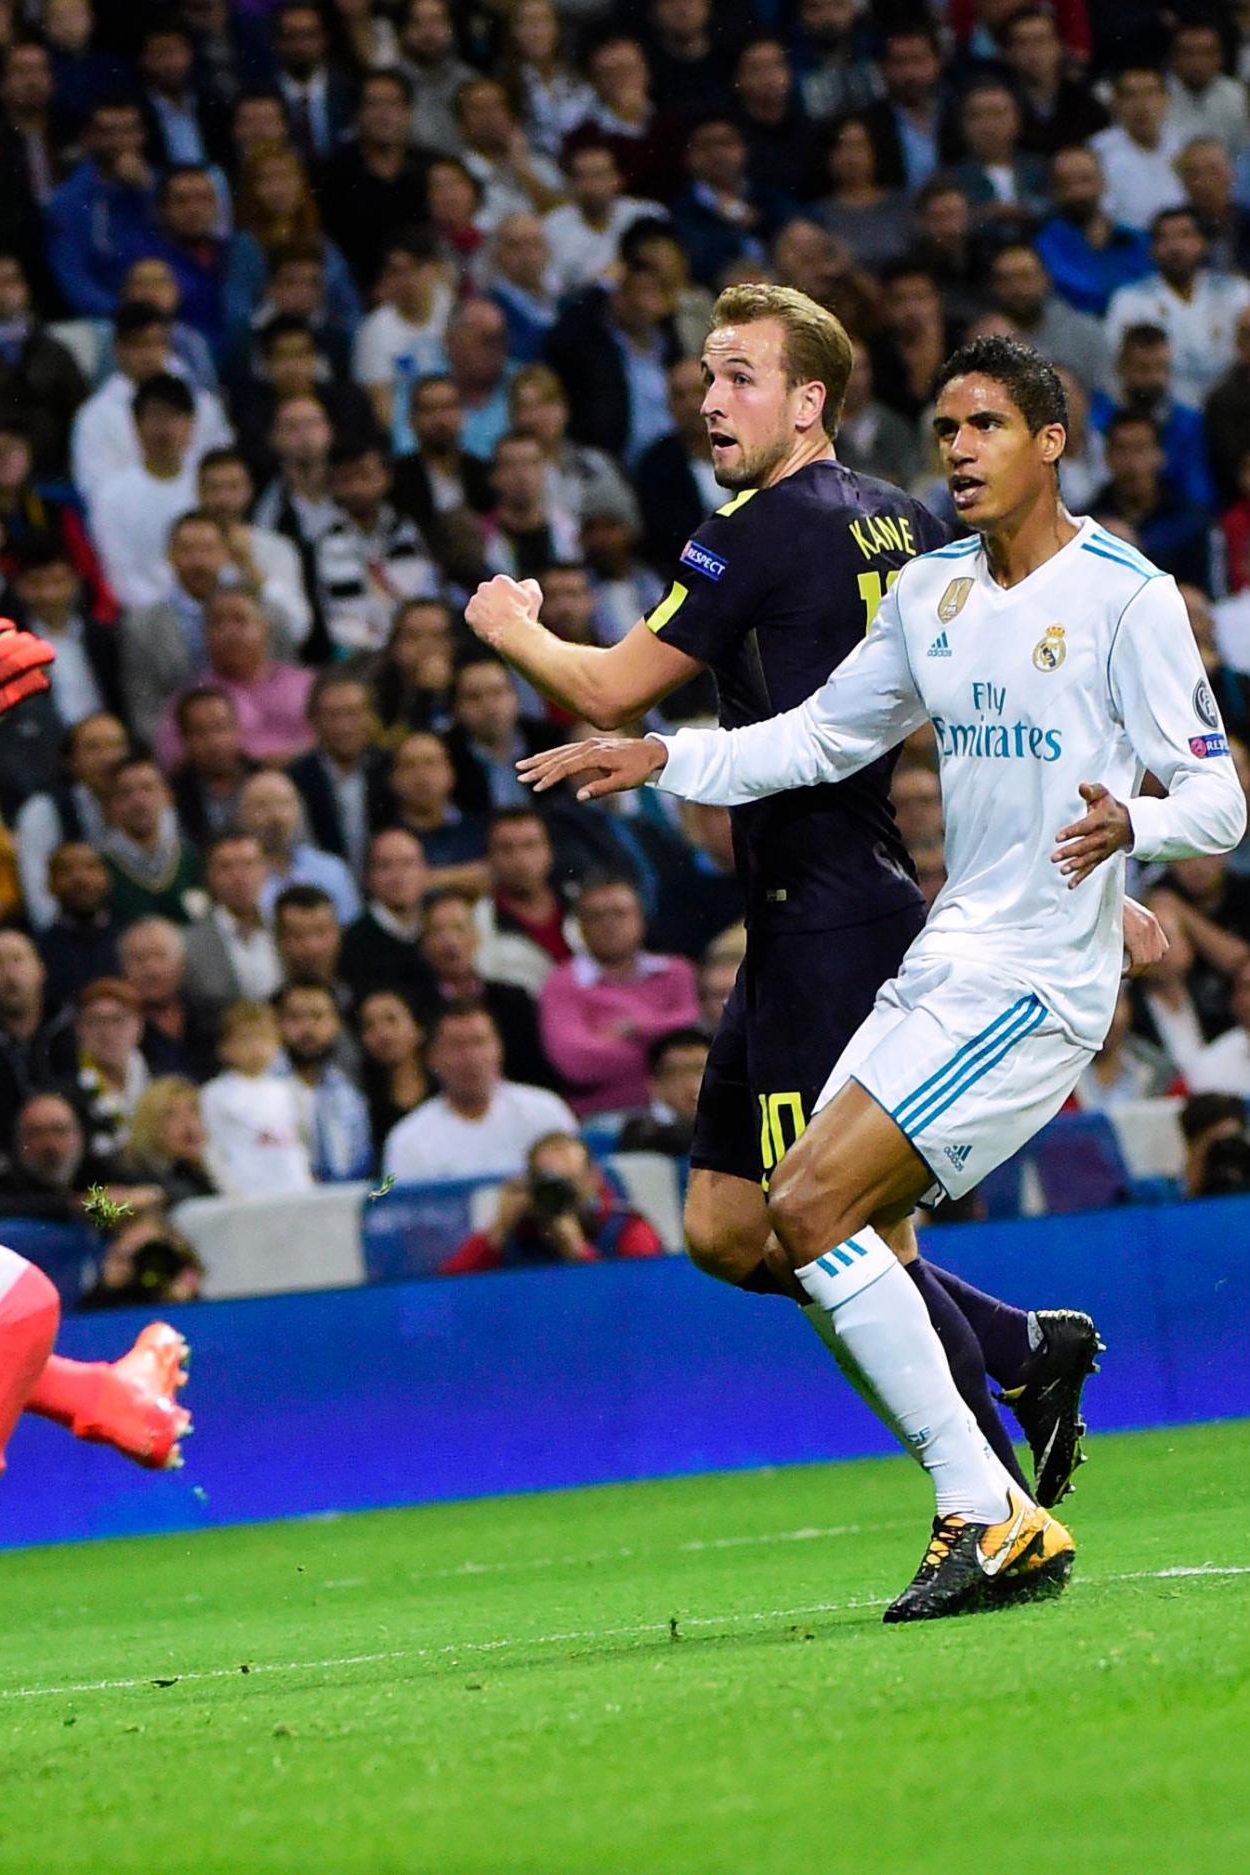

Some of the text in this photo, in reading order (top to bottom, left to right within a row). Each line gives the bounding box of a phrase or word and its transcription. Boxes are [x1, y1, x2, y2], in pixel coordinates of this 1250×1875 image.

[849, 516, 916, 560] KANE
[687, 547, 726, 576] RESPECT
[972, 682, 1006, 716] Fly
[931, 715, 1062, 762] Emirates
[758, 1091, 807, 1170] 10
